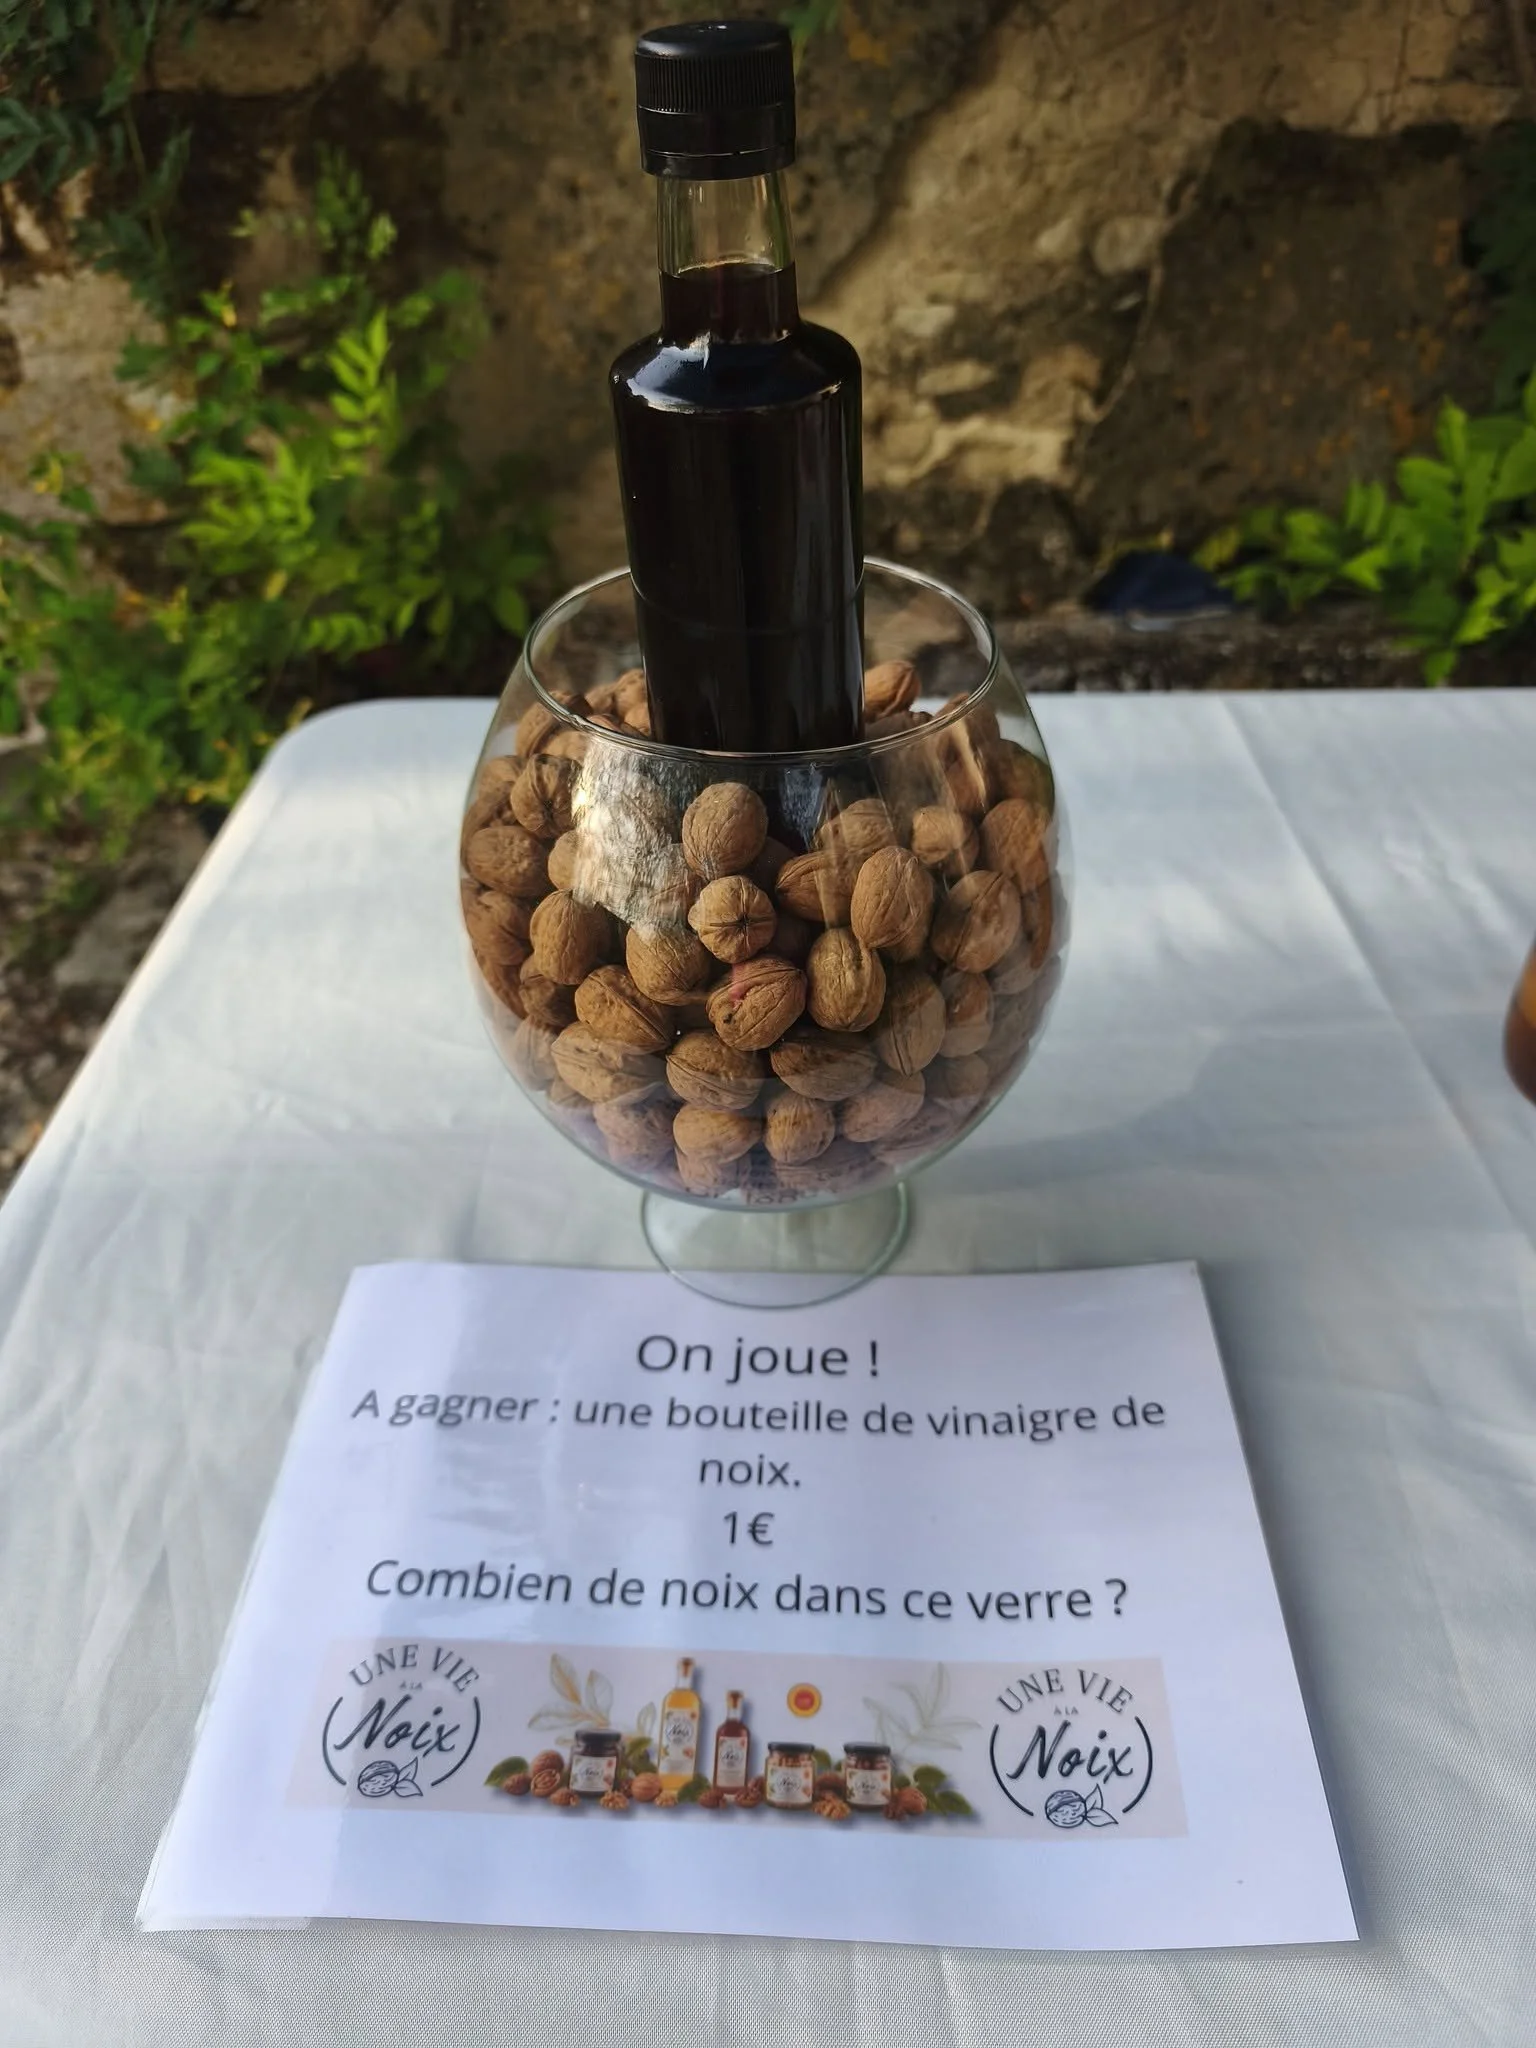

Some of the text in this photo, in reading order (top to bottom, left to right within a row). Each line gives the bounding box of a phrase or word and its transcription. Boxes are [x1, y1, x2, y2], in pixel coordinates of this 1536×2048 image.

[635, 1334, 879, 1386] On joue !
[350, 1389, 1166, 1445] A gagner : une bouteille de vinaigre de
[698, 1453, 801, 1489] noix.
[723, 1510, 775, 1548] 1€
[366, 1558, 1129, 1622] Combien de noix dans ce verre ?
[349, 1644, 480, 1692] UNE VIE
[997, 1668, 1133, 1713] UNE VIE
[333, 1694, 461, 1757] Noix
[1006, 1720, 1133, 1784] Noix
